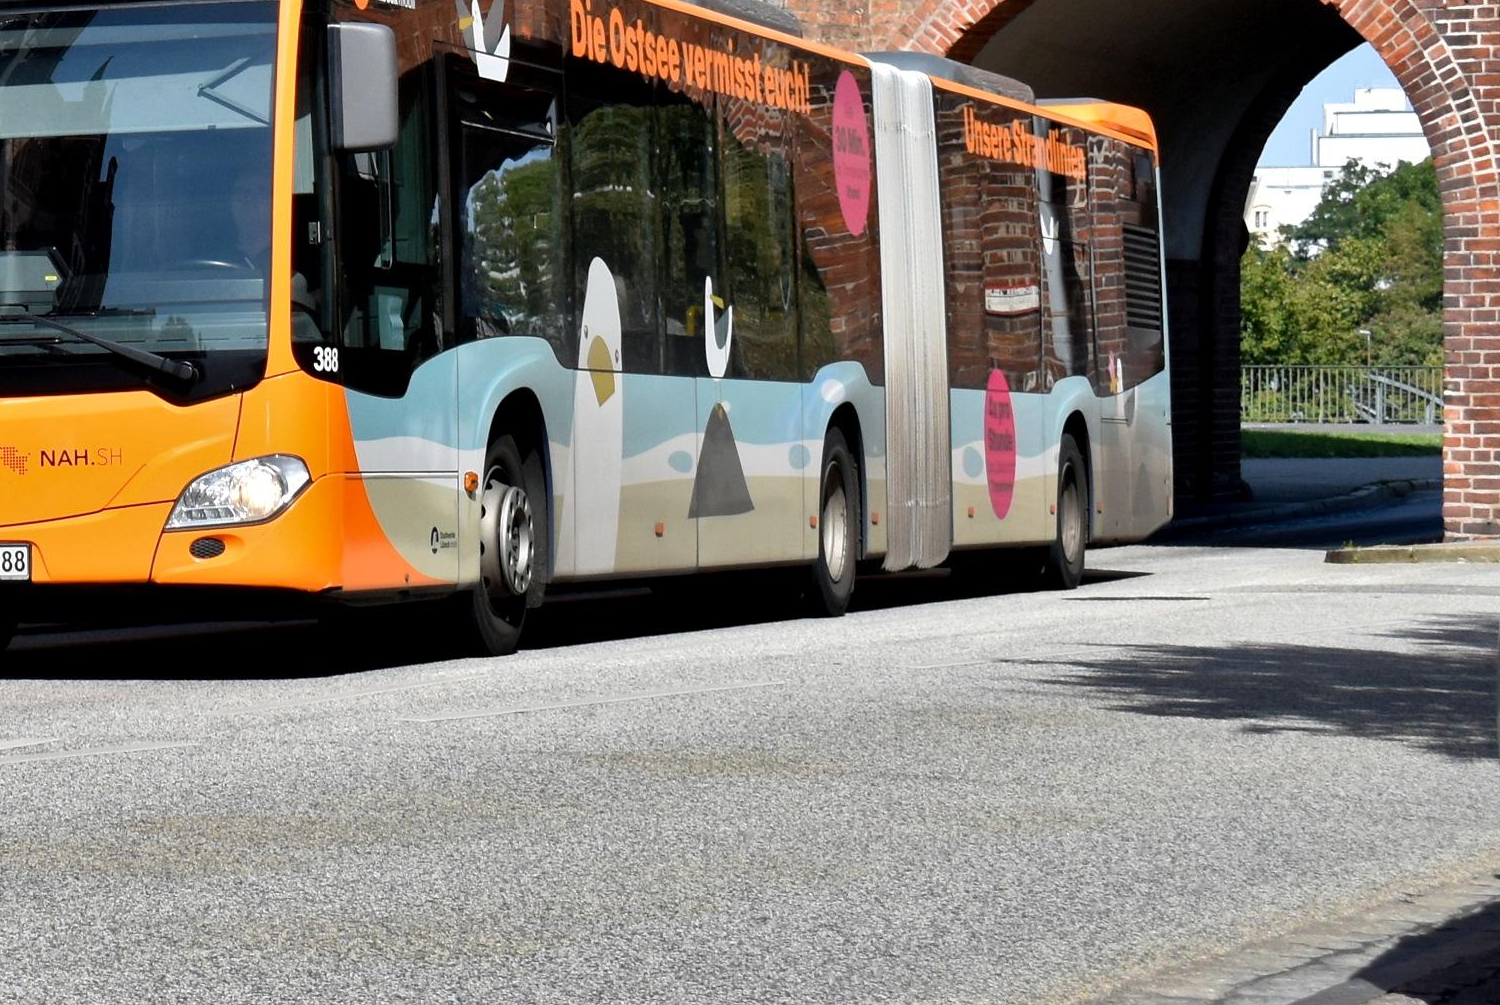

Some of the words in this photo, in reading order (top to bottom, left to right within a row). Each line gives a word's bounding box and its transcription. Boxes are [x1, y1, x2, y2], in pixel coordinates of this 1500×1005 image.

[609, 7, 681, 83] Ostsee
[682, 37, 764, 104] vermisst
[764, 56, 812, 115] euch!
[963, 105, 1012, 163] Unsere
[1012, 119, 1087, 180] Strandlinien
[313, 346, 339, 372] 388
[40, 447, 123, 468] NAH.SH
